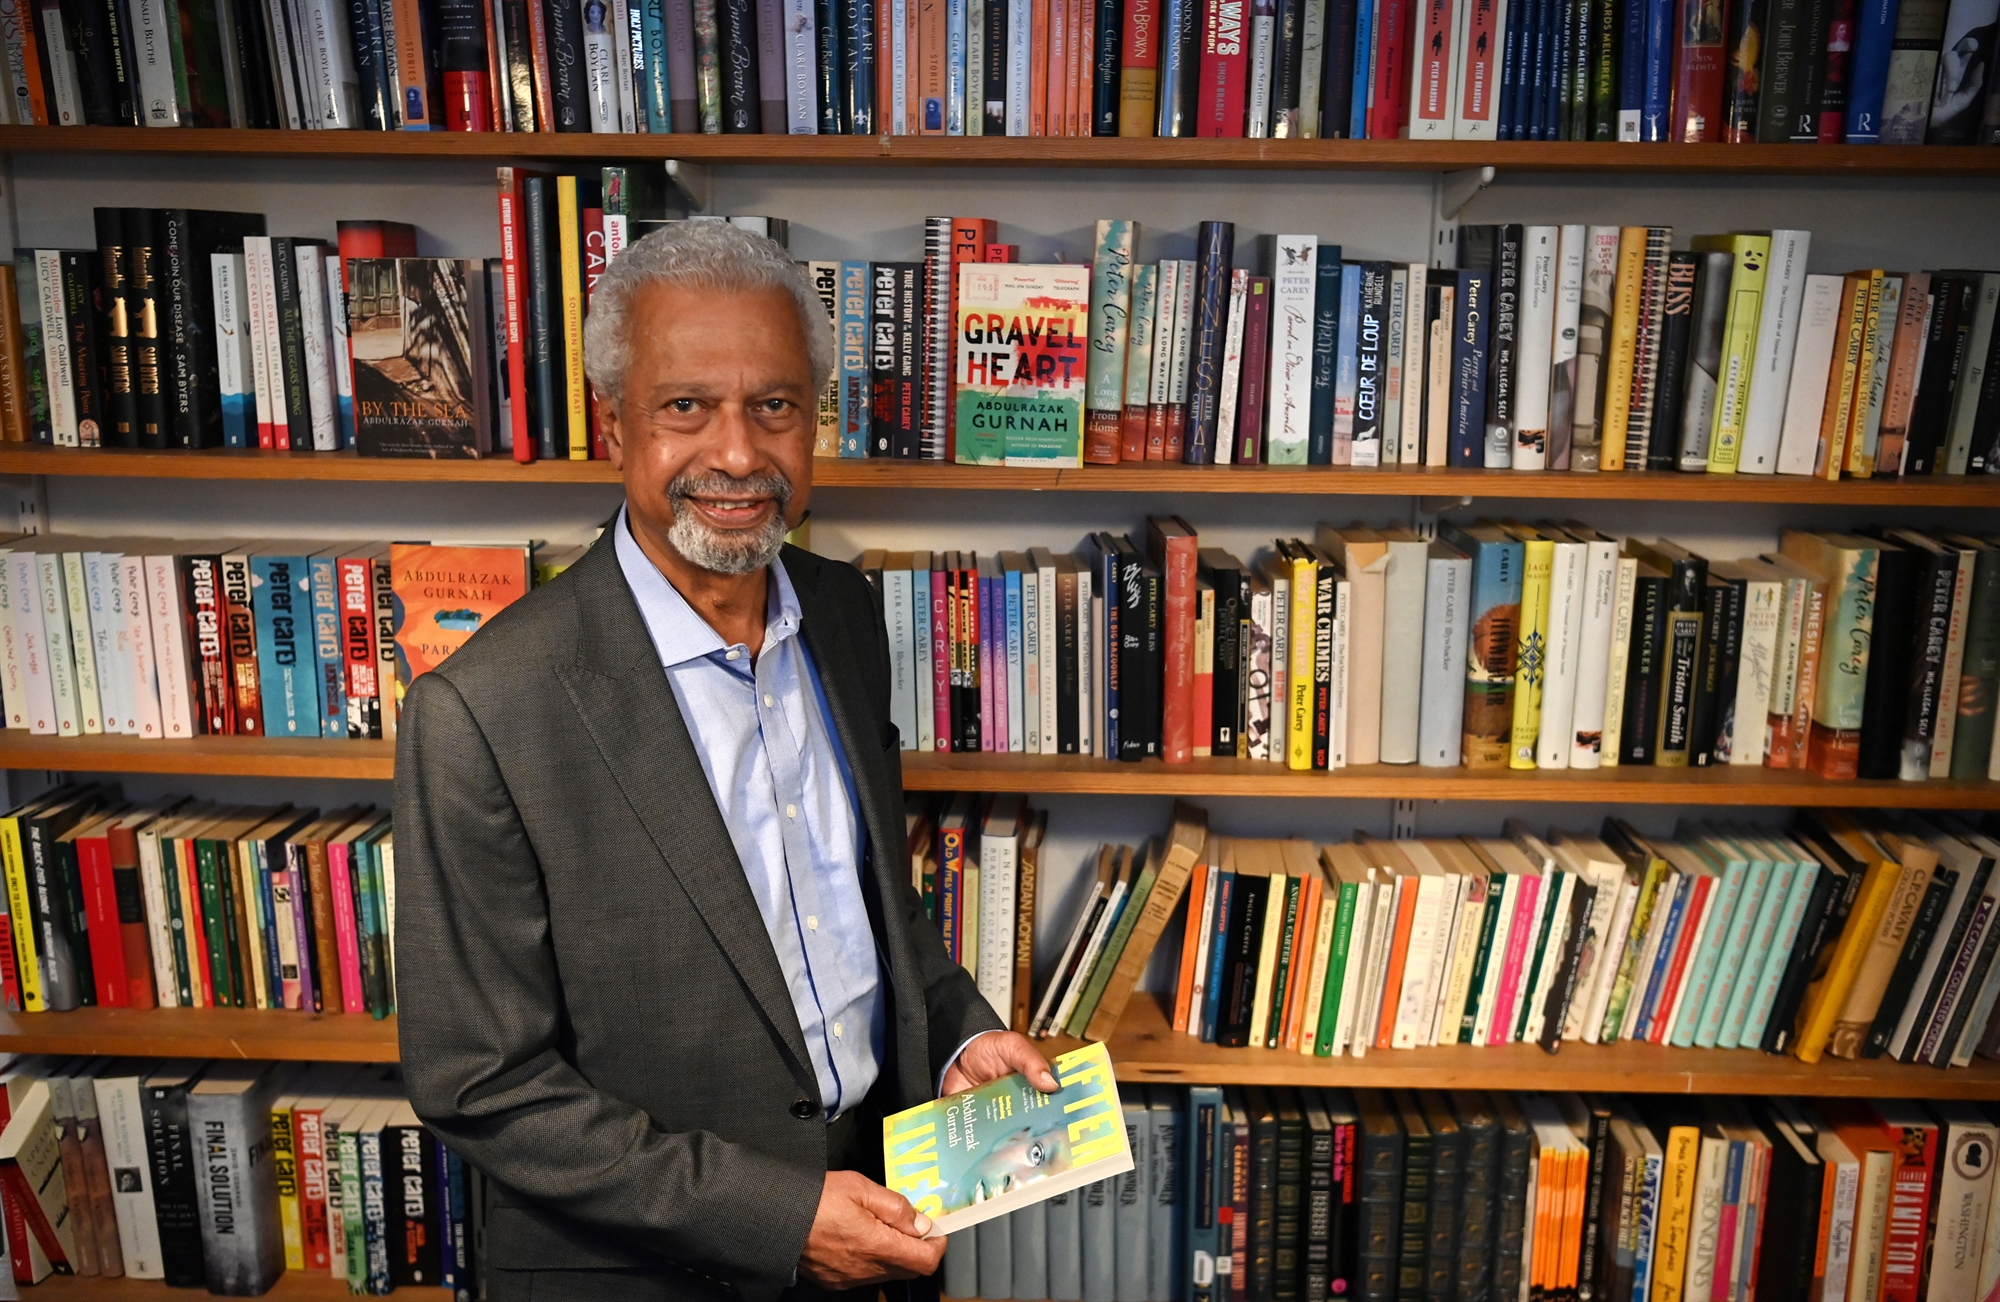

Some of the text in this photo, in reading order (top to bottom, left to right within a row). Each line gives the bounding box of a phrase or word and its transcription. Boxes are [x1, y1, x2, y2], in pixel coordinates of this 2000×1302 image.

[110, 16, 120, 39] VIEW
[116, 51, 124, 82] WINTER
[314, 10, 331, 86] CLARE BOYLAN
[406, 41, 416, 82] STORIES
[630, 8, 645, 70] HOLY PICTURES
[1134, 14, 1150, 58] BROWN
[1171, 30, 1180, 70] LONDON
[1207, 31, 1215, 54] PEOPLE
[1257, 34, 1269, 70] Pancras
[1576, 2, 1587, 103] TOWARDS MELLBREAK
[1773, 20, 1796, 95] JOHN BREWER
[589, 43, 610, 92] CLARE BOYLAN
[796, 34, 806, 120] CLARE BOYLAN
[971, 33, 980, 111] CLARE BOYLAN
[1215, 62, 1226, 122] SIMON BRADLEY
[1428, 61, 1440, 112] PETER BRADSHAW
[502, 198, 514, 260] ANTONIO CARLUCCIO
[168, 220, 184, 344] COME JOIN OUR DISEASE
[904, 269, 913, 323] TRUE HISTORY
[1093, 248, 1130, 354] Peter Carey
[1280, 286, 1311, 294] CAREY
[1282, 277, 1311, 285] PETER
[1365, 271, 1375, 309] KATHERINE
[1373, 274, 1384, 306] RUNDELL
[1499, 242, 1517, 342] PETER CAREY
[1665, 262, 1696, 316] BLISS
[50, 258, 69, 387] Multitudes Lucy Caldwell
[250, 282, 261, 337] CALDWELL
[569, 296, 577, 345] SOUTHERN
[964, 313, 1083, 349] GRAVEL
[1363, 313, 1380, 351] LOUP
[1464, 278, 1481, 346] Peter Carey
[176, 354, 188, 414] SAM BYERS
[255, 340, 266, 398] INTIMACIES
[572, 347, 580, 385] ITALIAN
[902, 333, 912, 431] KELLY GANG PETER CAREY
[966, 351, 1078, 388] HEART
[1102, 374, 1110, 384] A
[1361, 354, 1377, 372] DE
[1498, 350, 1508, 420] HIS ILLEGAL SELF
[362, 401, 468, 418] BY THE SEA
[976, 401, 1064, 414] ABDULRAZAK
[1092, 409, 1118, 421] From
[1094, 387, 1119, 400] Long
[1095, 398, 1117, 410] Way
[1155, 404, 1163, 427] HOME
[363, 417, 468, 427] ABDULRAZAK GURNAH
[972, 415, 1068, 432] GURNAH
[1090, 422, 1119, 433] Home
[403, 570, 512, 586] ABDULRAZAK
[1499, 548, 1510, 584] CAREY
[423, 587, 493, 600] GURNAH
[1026, 584, 1037, 656] PETER CAREY
[934, 599, 946, 693] CAREY
[1315, 577, 1333, 684] WAR CRIMES
[1806, 590, 1823, 655] AMNESIA
[1294, 683, 1307, 733] Peter Carey
[1669, 657, 1692, 744] Tristan Smith
[944, 832, 960, 857] OLD
[944, 893, 952, 918] FAIRY
[986, 848, 998, 992] BURNING YOUR BOATS
[998, 848, 1011, 996] ANGELA CARTER
[1281, 884, 1299, 965] ANGELA CARTER
[1, 920, 14, 981] CHANDLER
[1016, 912, 1032, 967] WOMAN
[946, 1106, 958, 1148] Gurnah
[962, 1093, 981, 1152] Abdulrazak
[1056, 1045, 1124, 1168] AFTER
[205, 1121, 235, 1235] FINAL SOLUTION
[1885, 1183, 1924, 1274] HAMILTON
[1954, 1191, 1974, 1270] WASHINGTON
